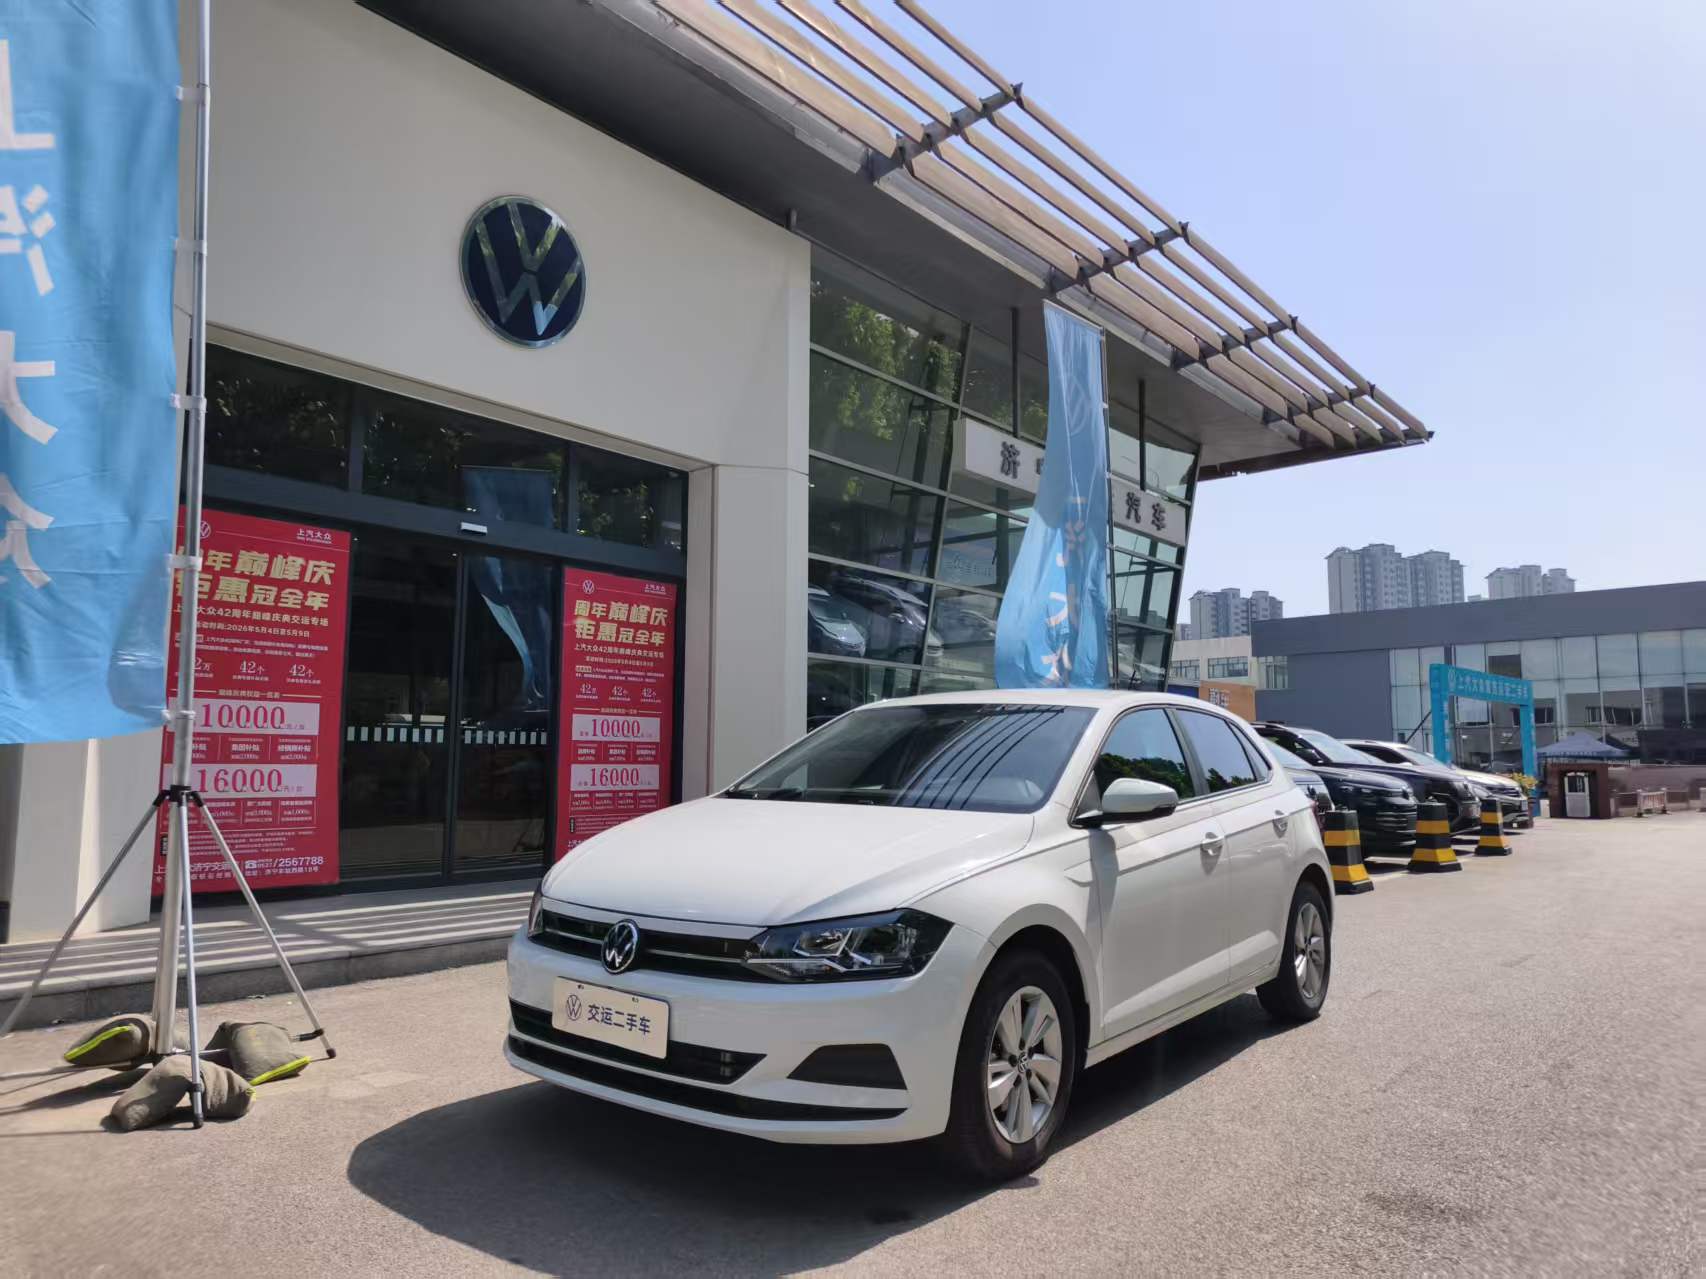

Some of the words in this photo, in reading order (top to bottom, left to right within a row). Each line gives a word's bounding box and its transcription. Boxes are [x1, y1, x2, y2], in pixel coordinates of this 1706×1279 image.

[176, 547, 336, 585] 年巅峰庆
[574, 600, 668, 627] 周年巅峰庆
[200, 703, 285, 730] 10000
[591, 718, 641, 738] 10000
[197, 768, 283, 793] 16000
[590, 767, 639, 787] 16000
[587, 1003, 651, 1036] 交运二手车
